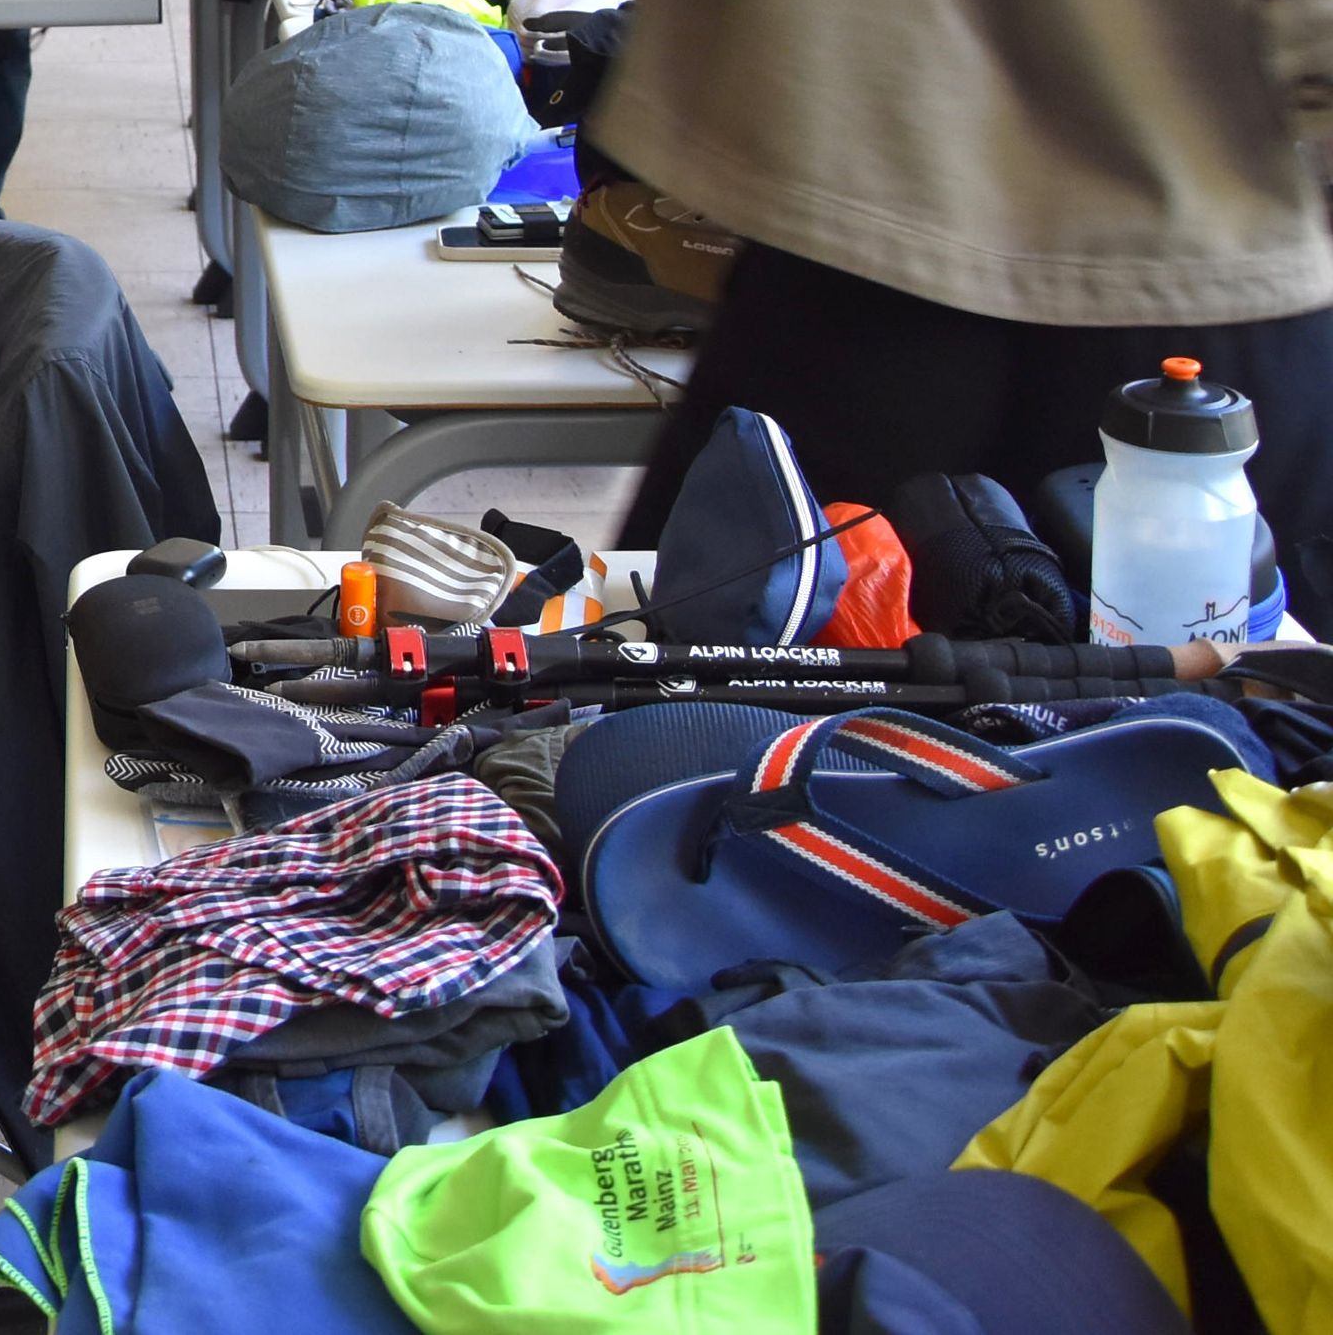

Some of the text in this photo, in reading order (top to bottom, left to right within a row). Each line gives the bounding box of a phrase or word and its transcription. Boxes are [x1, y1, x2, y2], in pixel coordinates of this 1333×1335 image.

[689, 645, 840, 661] ALPIN LOACKER
[728, 679, 885, 689] ALPIN LOACKER
[591, 1146, 623, 1259] Gutenberg
[652, 1168, 678, 1233] Mainz
